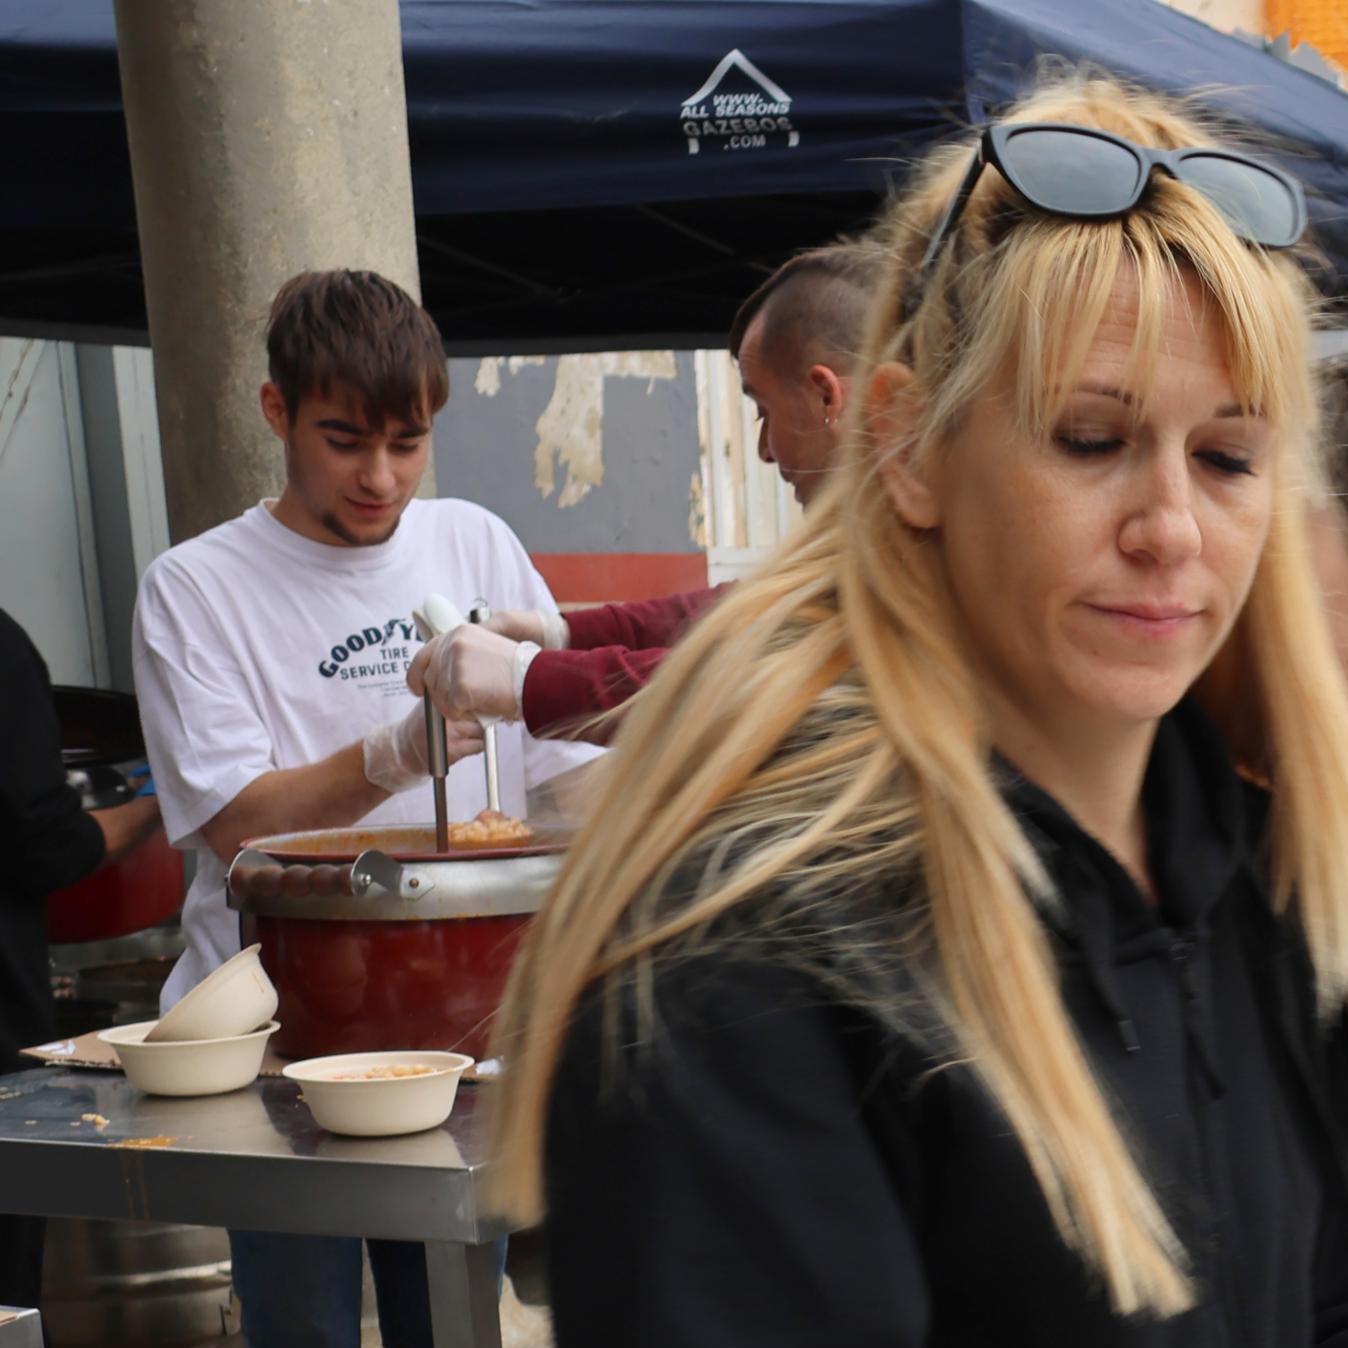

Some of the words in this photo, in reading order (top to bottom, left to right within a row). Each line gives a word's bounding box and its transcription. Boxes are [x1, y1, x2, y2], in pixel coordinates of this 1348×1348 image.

[680, 105, 709, 118] ALL
[715, 102, 790, 117] SEASONS
[683, 116, 793, 136] GAZEBOS
[724, 135, 766, 150] .COM
[380, 647, 409, 660] TIRE
[340, 662, 398, 680] SERVICE
